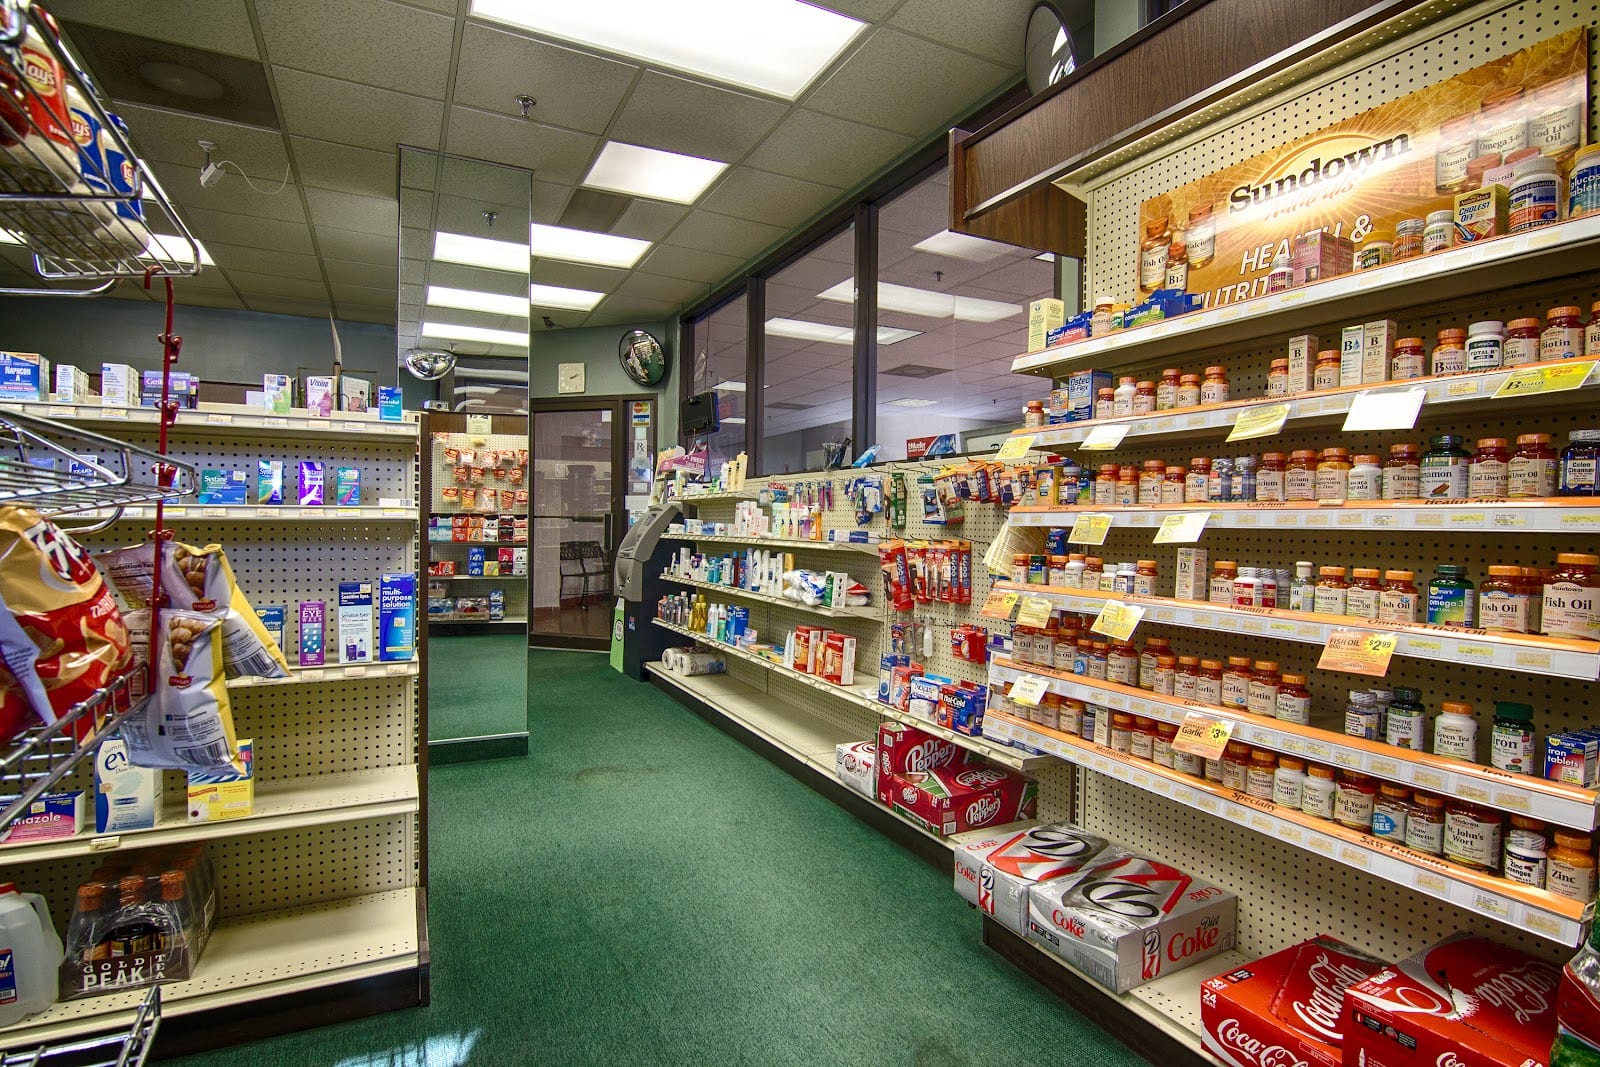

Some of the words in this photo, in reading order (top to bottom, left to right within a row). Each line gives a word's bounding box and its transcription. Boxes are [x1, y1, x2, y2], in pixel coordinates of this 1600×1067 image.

[1532, 129, 1549, 138] Cod
[1552, 119, 1576, 133] Liver
[1479, 138, 1508, 151] Omega
[1545, 134, 1561, 144] Oil
[1440, 157, 1467, 168] Vitamin
[1230, 133, 1412, 214] Sundown
[1459, 201, 1490, 216] CHOLEST
[1351, 214, 1373, 243] &
[1143, 260, 1156, 268] Fish
[1169, 275, 1184, 285] B12
[1344, 341, 1353, 351] B
[1371, 337, 1379, 346] B
[1541, 340, 1571, 350] Biotin
[1294, 349, 1302, 358] B
[1393, 362, 1400, 372] B
[1435, 362, 1445, 373] B
[16, 374, 20, 383] A
[310, 378, 329, 388] Visine
[1317, 377, 1332, 385] B12
[204, 475, 228, 483] Systane
[110, 563, 141, 571] Nutrition
[1211, 585, 1230, 594] DHEA
[1429, 600, 1457, 608] omega
[1482, 603, 1498, 612] Fish
[1502, 604, 1518, 613] Oil
[1545, 597, 1566, 608] Fish
[1571, 599, 1592, 610] Oil
[1020, 640, 1031, 648] Oil
[1223, 683, 1244, 694] Garlic
[1182, 726, 1204, 738] Garlic
[1436, 731, 1457, 742] Green
[923, 736, 941, 757] Dr
[1439, 738, 1465, 748] Extract
[1493, 735, 1517, 749] Iron
[1095, 745, 1131, 761] Melatonin
[1548, 747, 1567, 756] iron
[910, 744, 956, 772] Pepper
[1548, 756, 1579, 767] tablets
[1276, 783, 1298, 792] Prostate
[977, 798, 990, 809] Dr
[1232, 791, 1278, 813] Specialty
[1338, 797, 1350, 806] Red
[1351, 801, 1369, 810] Yeast
[969, 803, 1000, 825] Pepper
[1344, 805, 1360, 815] Rice
[1408, 829, 1435, 840] Palmetto
[1414, 826, 1426, 834] Saw
[1447, 825, 1456, 835] St.
[1457, 827, 1485, 841] John's
[1452, 835, 1474, 847] Wort
[1510, 860, 1523, 870] Zinc
[956, 861, 976, 883] Coke
[1552, 869, 1577, 884] Zinc
[1052, 909, 1086, 939] Coke
[1073, 916, 1087, 928] Diet
[1201, 914, 1221, 930] Diet
[1167, 925, 1219, 963] Coke
[84, 956, 145, 974] GOLD
[155, 954, 166, 979] TEA
[84, 967, 145, 991] PEAK
[1202, 989, 1217, 1004] 24
